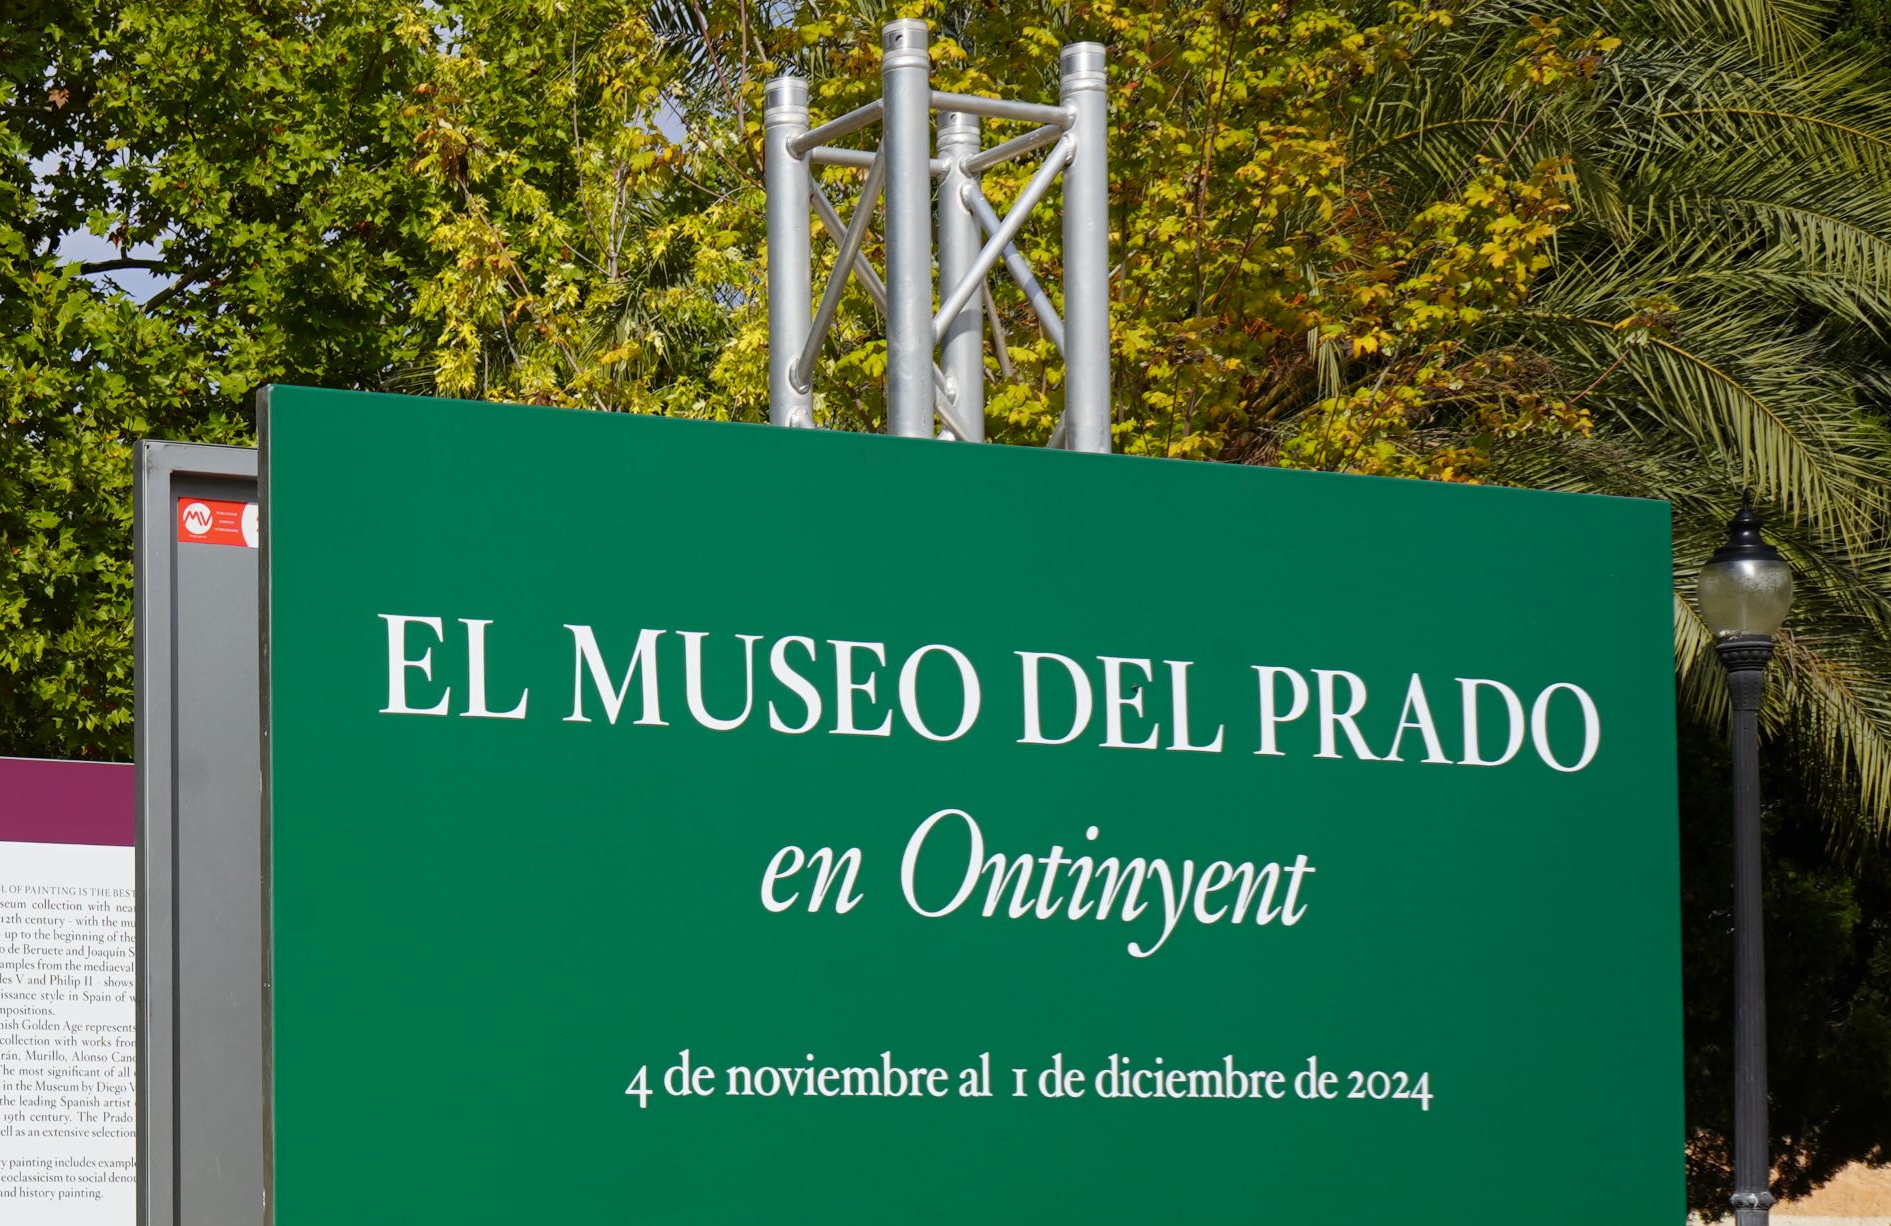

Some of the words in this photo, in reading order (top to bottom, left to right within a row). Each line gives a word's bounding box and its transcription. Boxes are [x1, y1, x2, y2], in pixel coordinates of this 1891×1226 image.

[378, 614, 528, 719] EL
[562, 624, 981, 741] MUSEO
[1014, 651, 1224, 752] DEL
[1251, 665, 1600, 772] PRADO
[761, 846, 863, 914] en
[901, 809, 1316, 958] Ontinyent
[19, 1064, 43, 1076] most
[47, 1065, 99, 1080] significant
[103, 1065, 115, 1077] of
[117, 1066, 129, 1077] all
[625, 1065, 653, 1109] 4
[664, 1049, 714, 1096] de
[726, 1050, 949, 1097] noviembre
[959, 1052, 993, 1097] al
[1038, 1053, 1085, 1098] de
[1095, 1053, 1285, 1098] diciembre
[1294, 1056, 1338, 1098] de
[1347, 1071, 1433, 1111] 2024
[19, 1095, 56, 1110] leading
[60, 1095, 100, 1110] Spanish
[103, 1096, 130, 1107] artist
[76, 1110, 98, 1122] The
[103, 1111, 132, 1122] Prado
[19, 1186, 55, 1201] history
